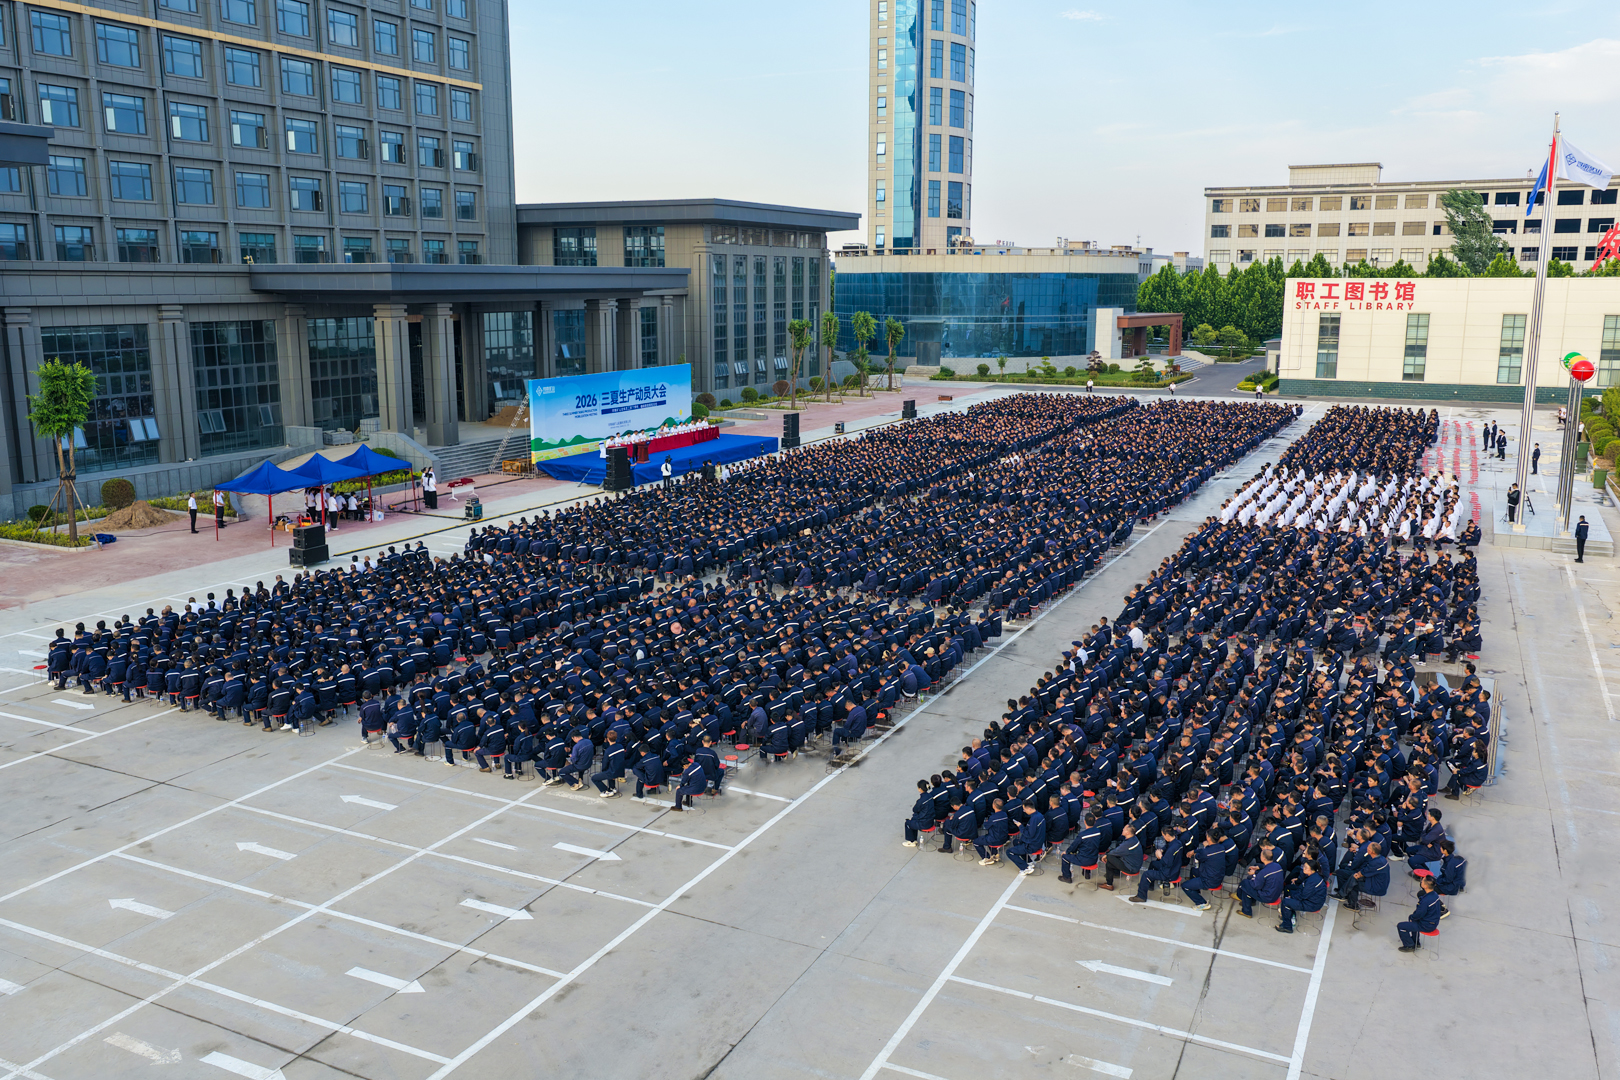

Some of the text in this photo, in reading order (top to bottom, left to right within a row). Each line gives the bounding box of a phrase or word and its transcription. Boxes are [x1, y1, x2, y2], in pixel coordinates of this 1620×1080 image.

[1295, 281, 1416, 301] 职工图书馆
[1295, 301, 1415, 310] STAFF LIBRARY
[576, 394, 598, 409] 2026
[601, 383, 667, 406] 三夏生产动员大会
